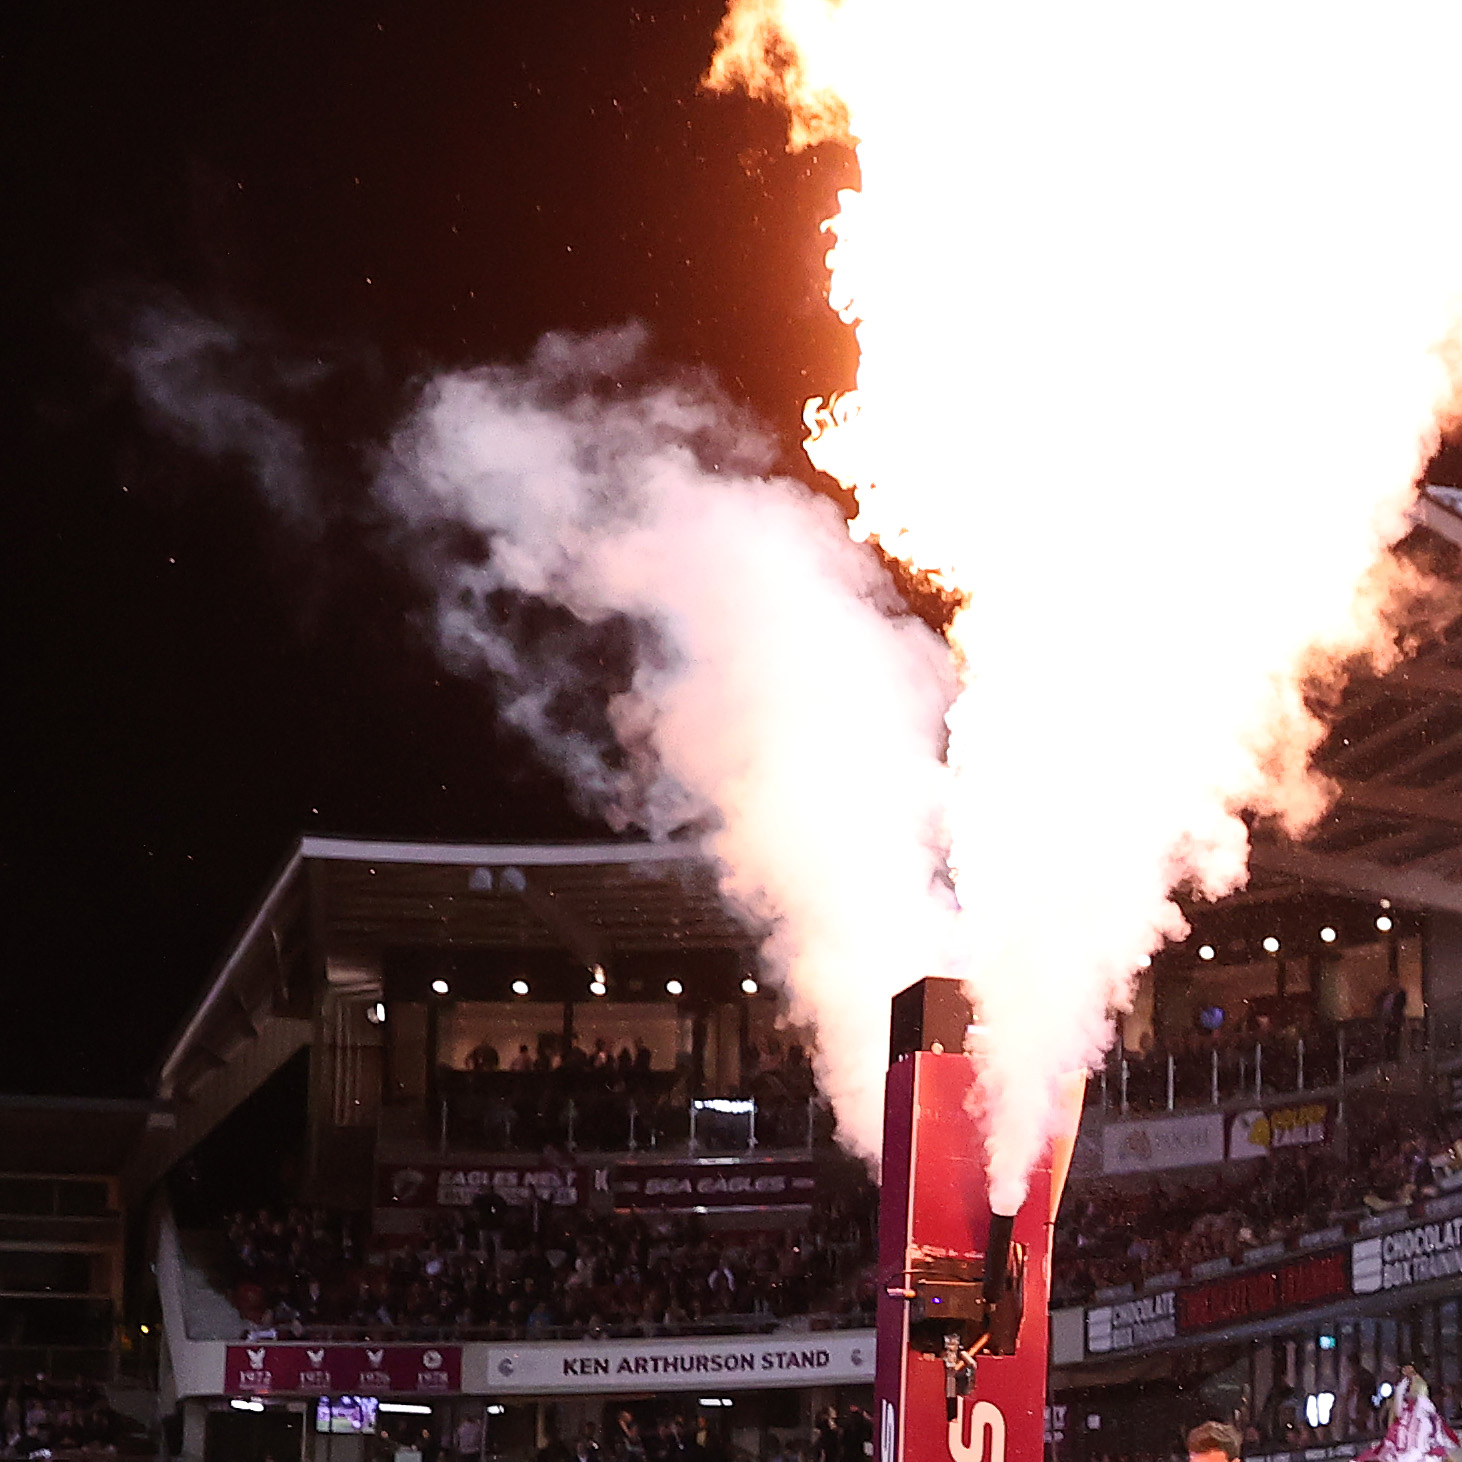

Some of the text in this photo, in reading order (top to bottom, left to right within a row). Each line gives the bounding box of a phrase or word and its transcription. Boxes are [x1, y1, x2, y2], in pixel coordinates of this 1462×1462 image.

[562, 1349, 831, 1377] KEN ARTHURSON STAND
